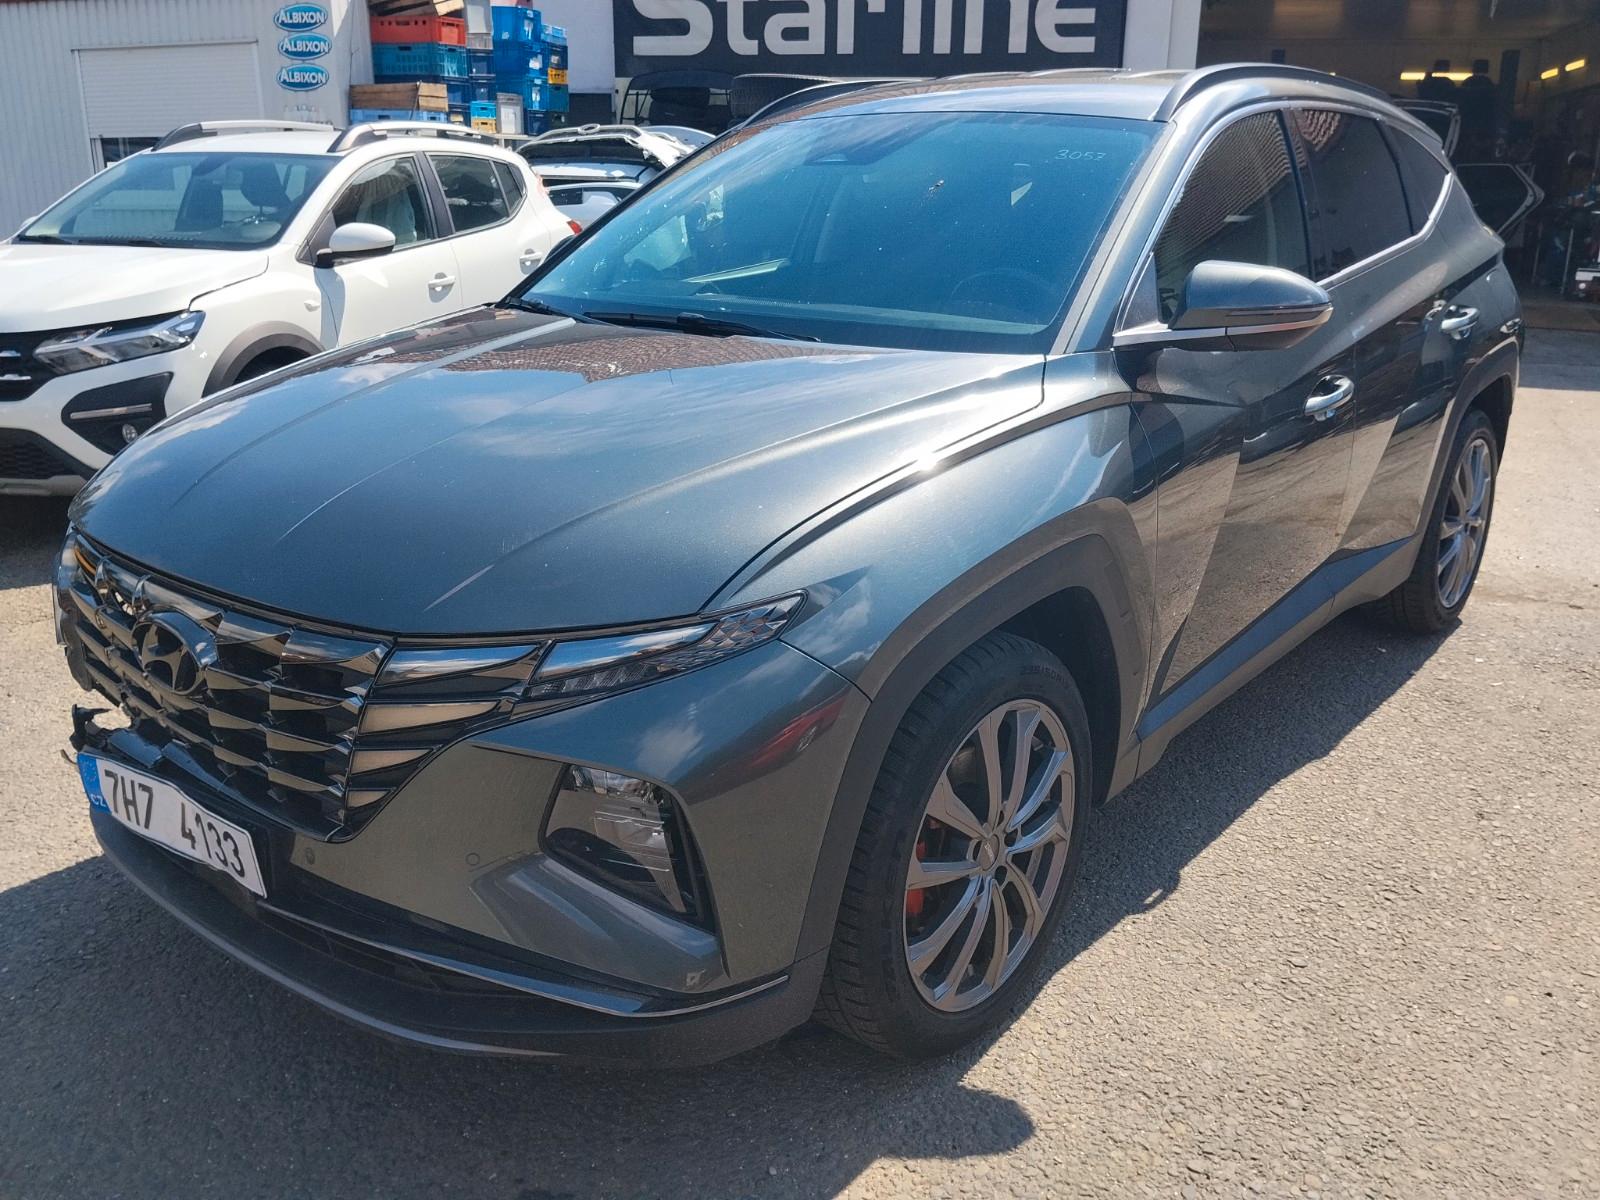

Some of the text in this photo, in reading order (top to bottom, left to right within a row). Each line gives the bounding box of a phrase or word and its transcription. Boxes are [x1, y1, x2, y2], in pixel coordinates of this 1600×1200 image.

[278, 9, 325, 24] ALBIXON
[633, 0, 1096, 56] Starline
[282, 38, 329, 53] ALBIXON
[280, 67, 326, 83] ALBIXON
[1055, 149, 1106, 161] 3057
[90, 793, 107, 808] CZ
[104, 769, 245, 878] 7H7 4133
